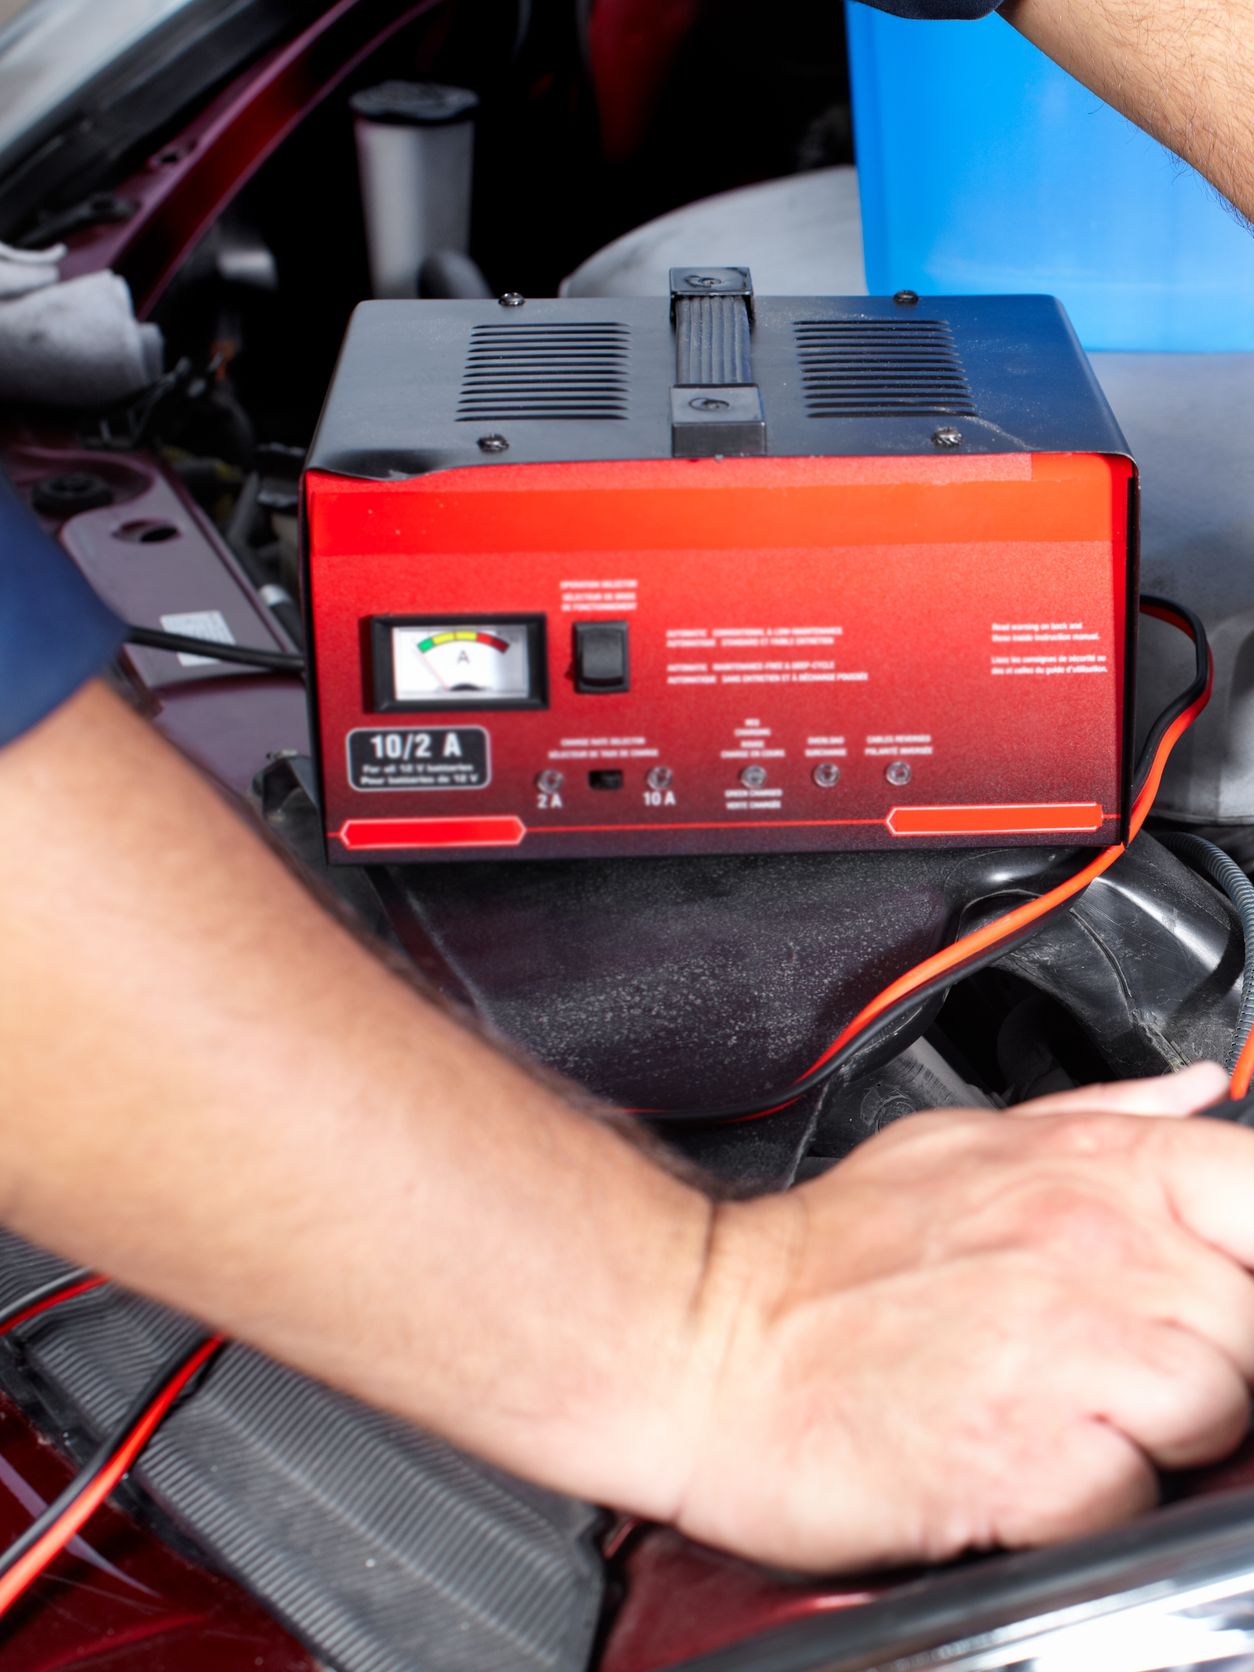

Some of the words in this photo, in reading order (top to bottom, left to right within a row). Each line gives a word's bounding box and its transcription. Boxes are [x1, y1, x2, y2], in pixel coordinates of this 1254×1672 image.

[992, 623, 1010, 631] Read
[1011, 623, 1039, 632] warning
[457, 650, 470, 664] A
[1046, 666, 1064, 675] guide
[370, 732, 432, 761] 10/2
[443, 732, 462, 758] A
[362, 765, 381, 773] For
[383, 764, 396, 773] all
[400, 764, 413, 772] 12
[415, 764, 425, 772] V
[427, 763, 474, 772] batteries
[360, 776, 385, 785] Pour
[388, 775, 434, 784] batteries
[437, 775, 450, 783] de
[453, 774, 467, 783] 12
[469, 774, 478, 782] V
[537, 794, 547, 809] 2
[550, 792, 562, 808] A
[642, 791, 661, 806] 10
[664, 790, 676, 806] A
